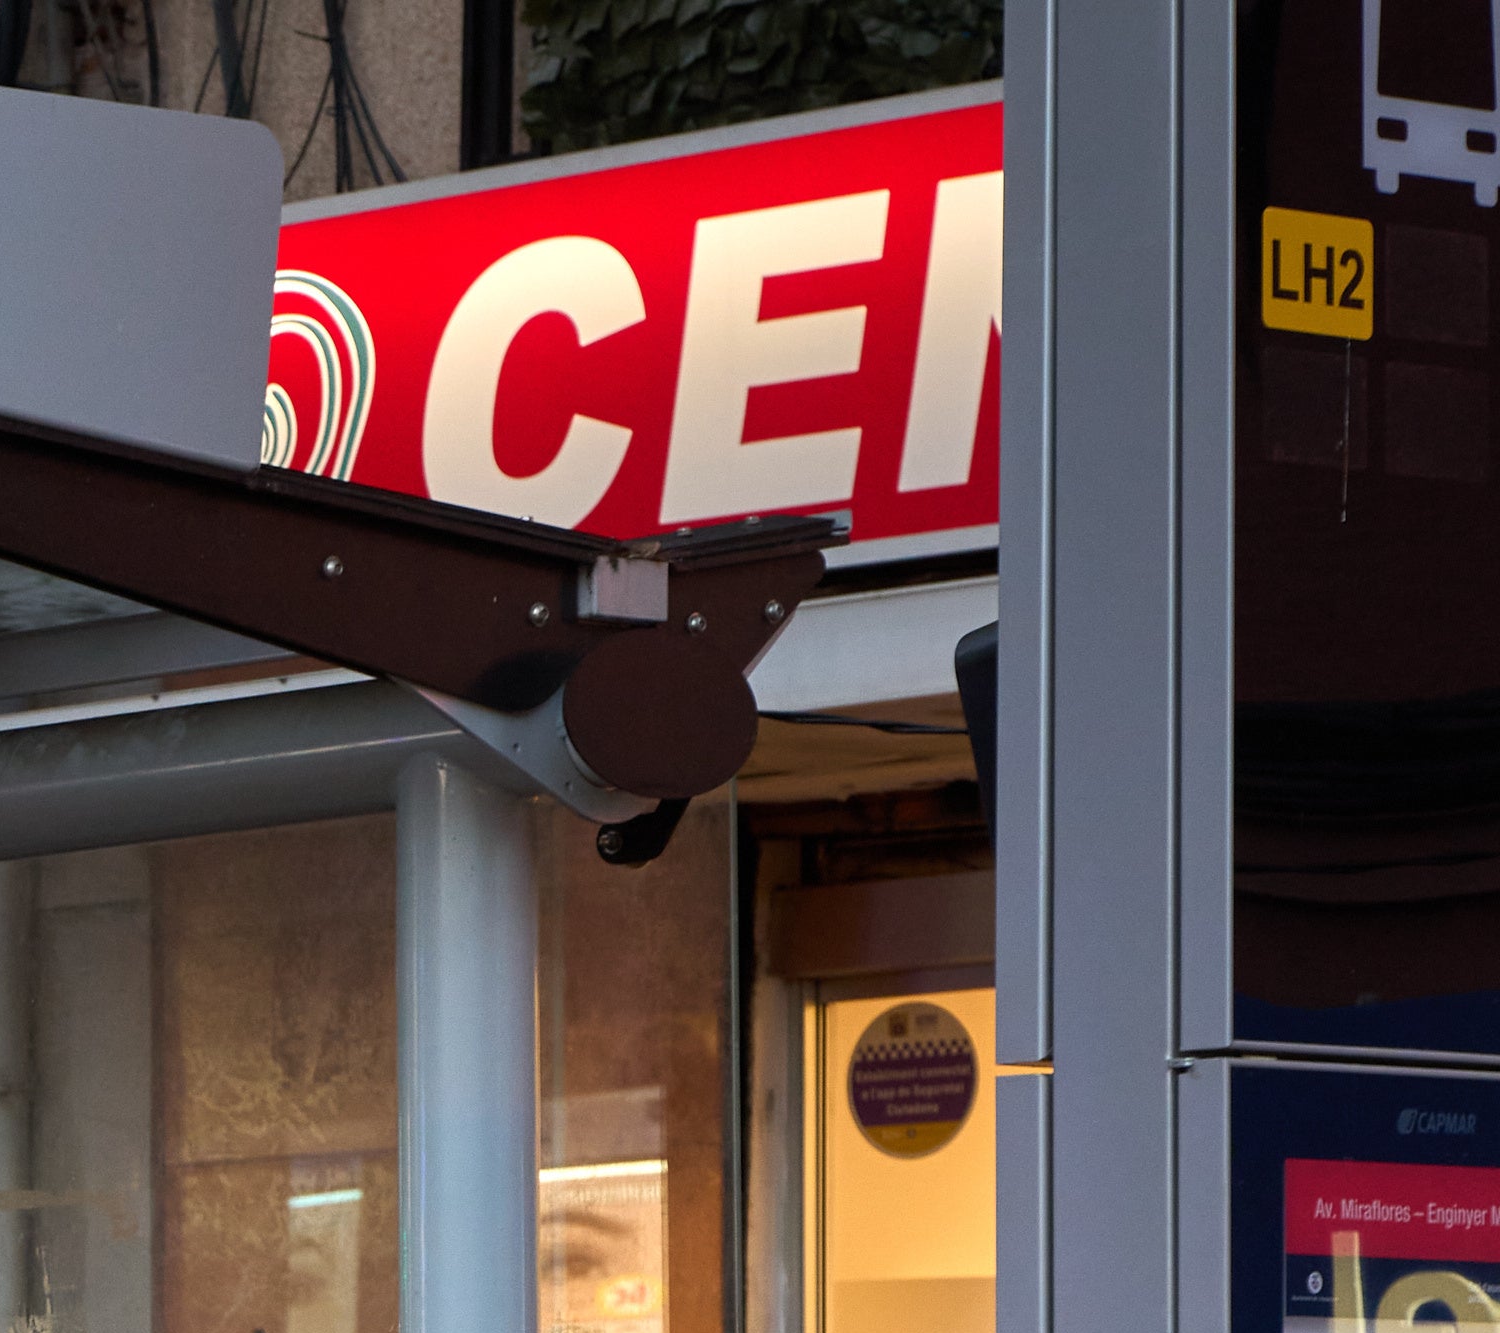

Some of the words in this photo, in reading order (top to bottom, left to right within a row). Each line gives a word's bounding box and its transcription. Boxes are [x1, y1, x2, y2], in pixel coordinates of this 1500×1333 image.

[1272, 239, 1365, 310] LH2
[1313, 1197, 1337, 1220] Av.
[1340, 1199, 1411, 1223] Miraflores
[1427, 1202, 1488, 1231] Enginyer
